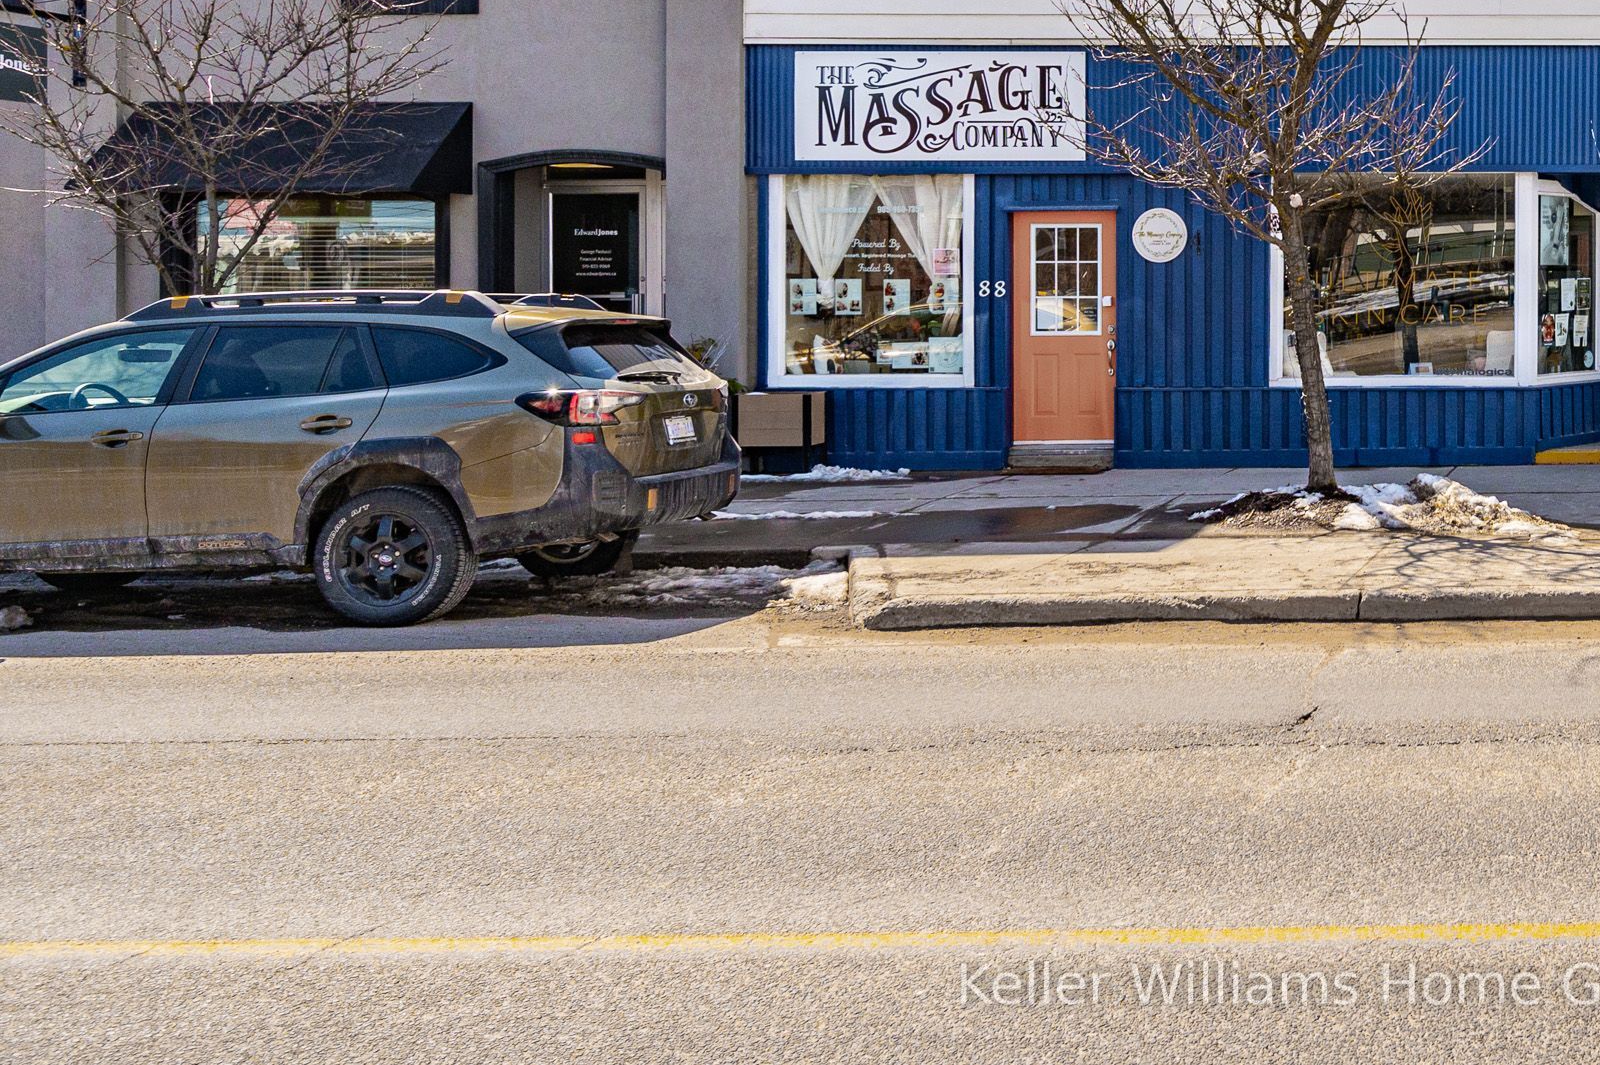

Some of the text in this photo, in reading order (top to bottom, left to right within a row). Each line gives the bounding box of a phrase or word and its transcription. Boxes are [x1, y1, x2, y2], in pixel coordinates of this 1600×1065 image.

[816, 65, 855, 84] THE
[814, 61, 1063, 154] MASSAGE
[951, 118, 1063, 151] COMPANY
[850, 239, 902, 251] Powered By
[857, 264, 895, 274] Fueled By
[978, 280, 1006, 297] 88
[1315, 270, 1485, 292] ULTIMATE
[1314, 304, 1489, 325] SKIN CARE
[1434, 368, 1514, 377] malogica
